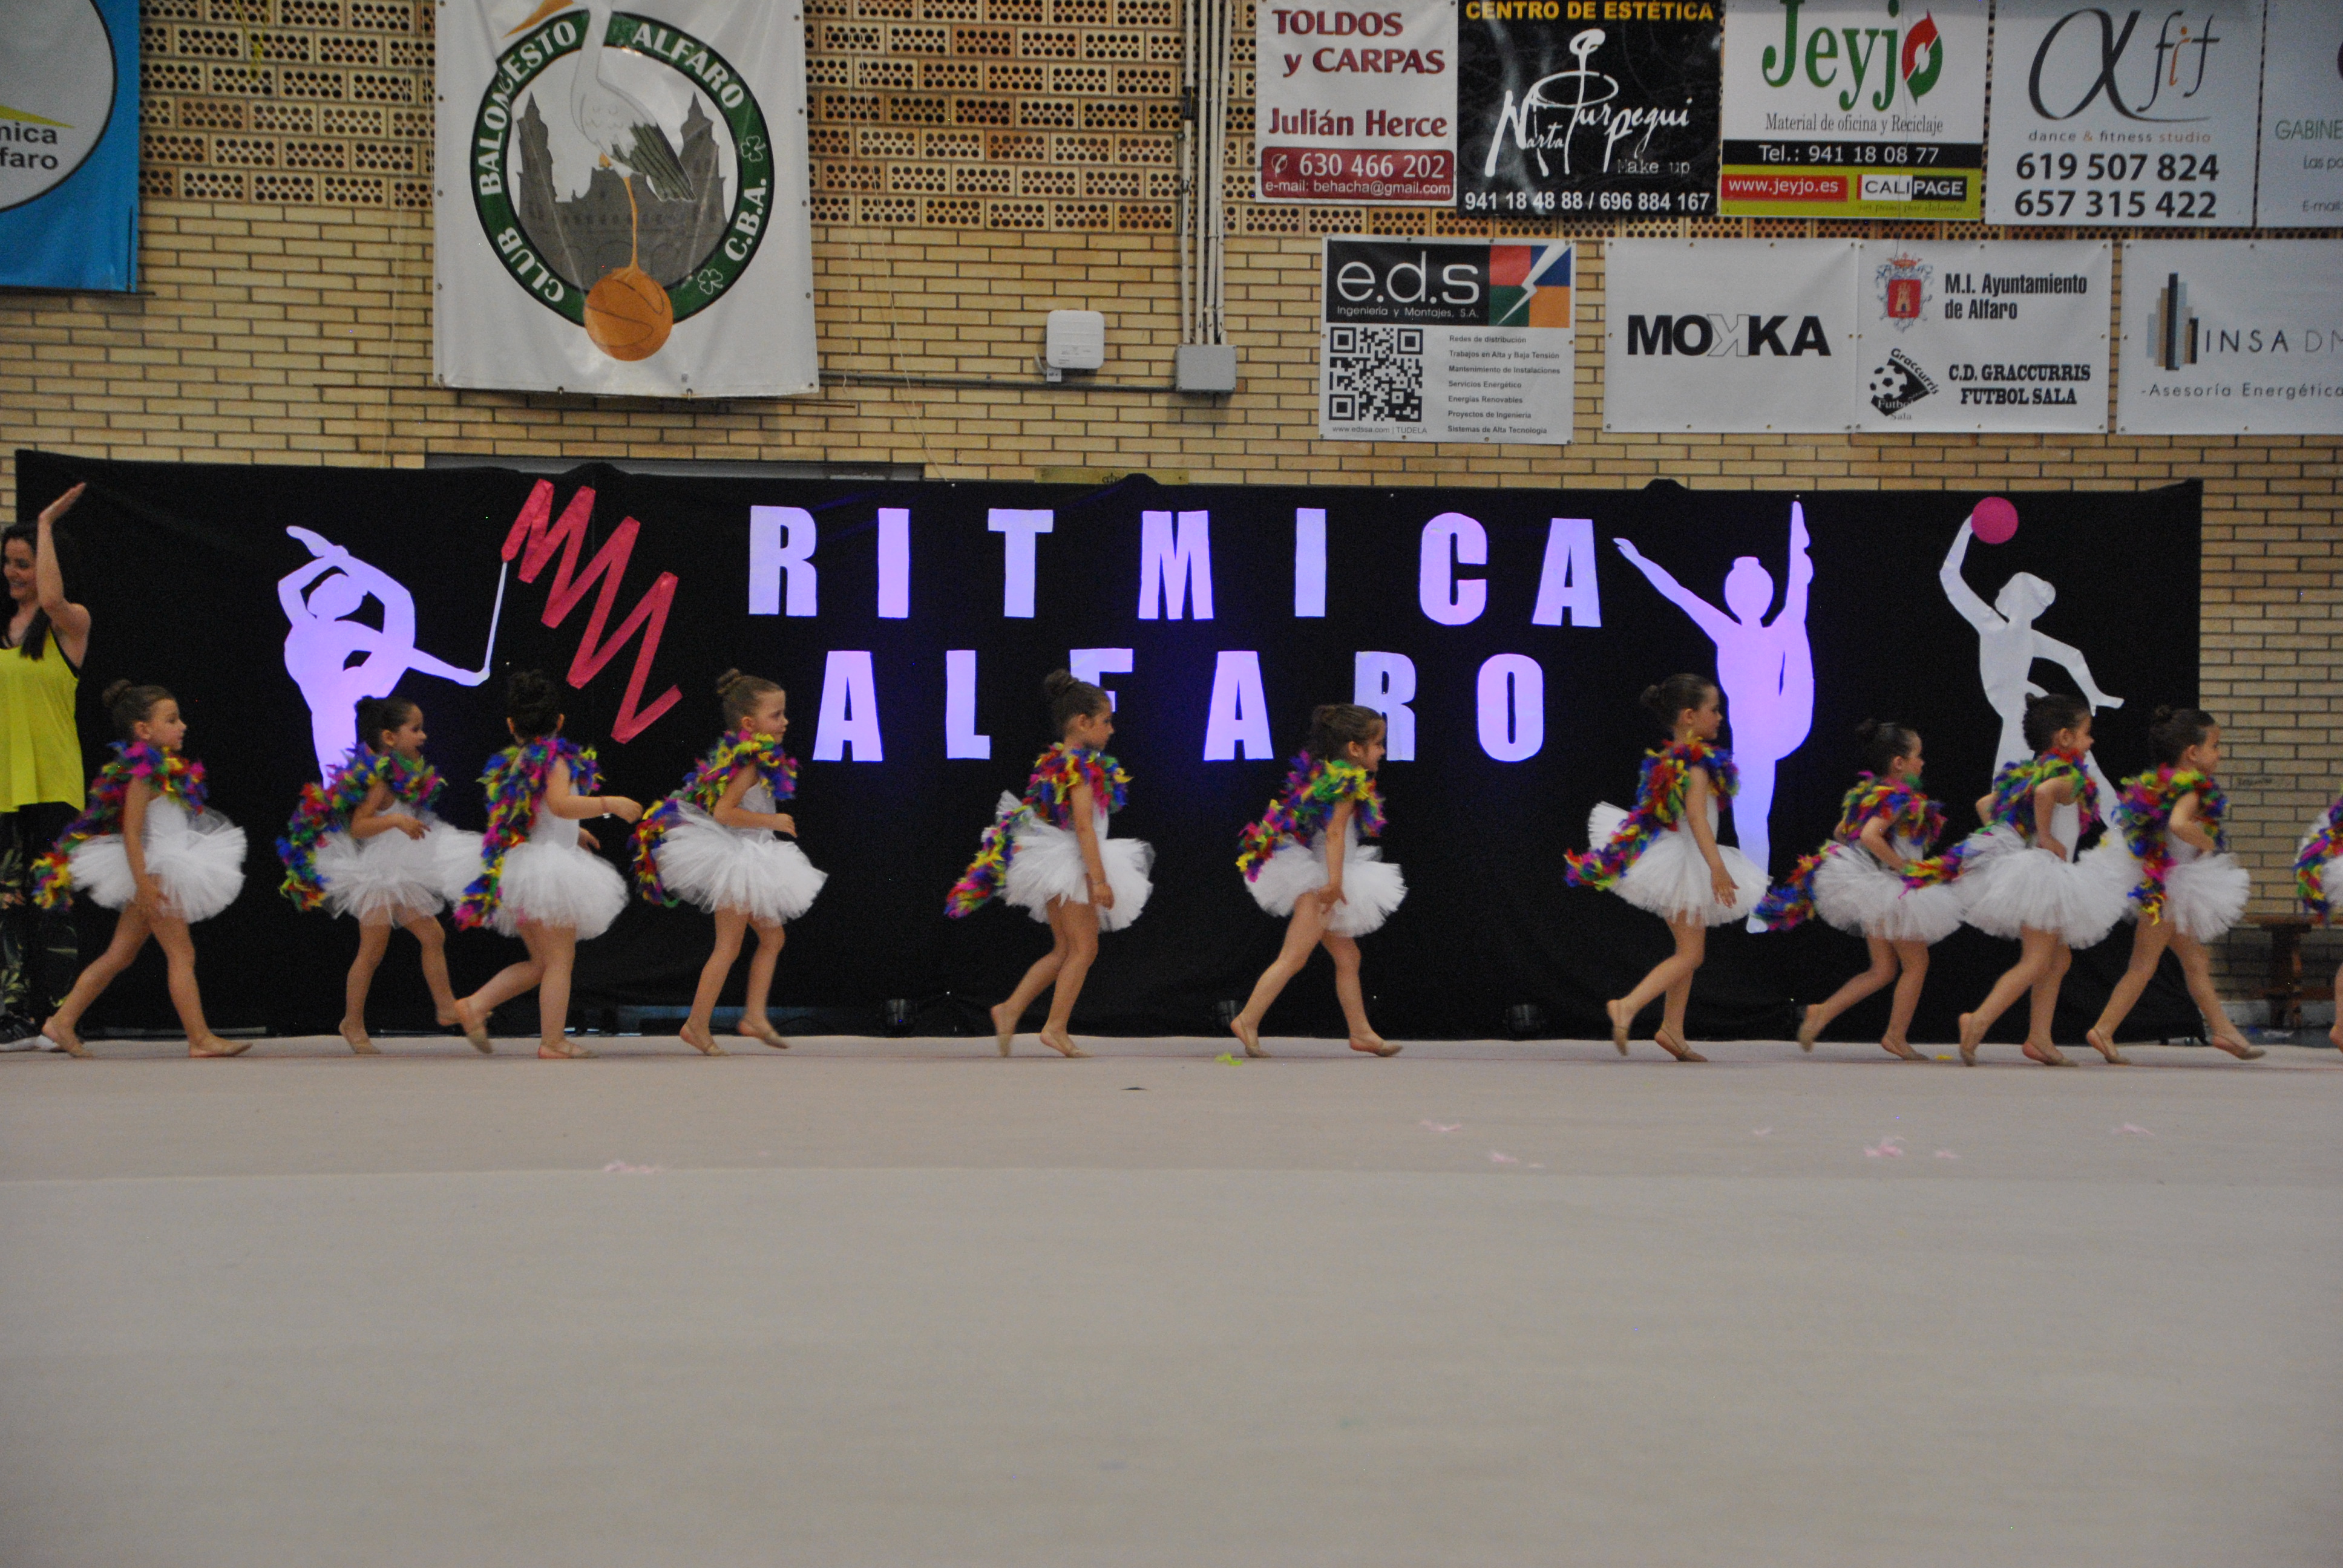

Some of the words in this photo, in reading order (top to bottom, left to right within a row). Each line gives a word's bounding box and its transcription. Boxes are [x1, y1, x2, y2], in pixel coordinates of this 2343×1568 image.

[1466, 1, 1560, 19] CENTRO
[1567, 1, 1596, 19] DE
[1604, 0, 1714, 21] ESTÉTICA
[1271, 9, 1403, 36] TOLDOS
[632, 23, 744, 109] ALFARO
[1282, 54, 1302, 78] y
[1312, 47, 1446, 74] CARPAS
[1268, 108, 1354, 136] Julián
[1366, 109, 1447, 137] Herce
[1766, 113, 1816, 131] Material
[1821, 113, 1834, 130] de
[1838, 113, 1876, 131] oficina
[1881, 120, 1888, 135] y
[1892, 114, 1943, 136] Reciclaje
[2029, 130, 2076, 142] dance
[2083, 131, 2092, 142] &
[2100, 131, 2152, 143] fitness
[2159, 131, 2211, 143] studio
[1299, 152, 1342, 177] 630
[1351, 154, 1394, 177] 466
[1403, 154, 1446, 179] 202
[1758, 144, 1799, 162] Tel.:
[1809, 145, 1843, 163] 941
[1853, 146, 1876, 163] 18
[1884, 146, 1907, 163] 08
[1916, 147, 1939, 164] 77
[1670, 162, 1689, 178] up
[2016, 152, 2077, 180] 619
[2086, 153, 2148, 180] 507
[2157, 153, 2220, 181] 824
[1265, 181, 1309, 192] e-mail:
[1314, 181, 1450, 196] behacha@gmail.com
[1728, 178, 1838, 195] www.jeyjo.es
[1465, 192, 1497, 210] 941
[1506, 192, 1526, 210] 18
[1533, 192, 1555, 210] 48
[1561, 192, 1584, 210] 88
[1600, 192, 1633, 211] 696
[1638, 192, 1671, 211] 884
[1678, 192, 1710, 211] 167
[2014, 190, 2076, 217] 657
[2085, 190, 2146, 217] 315
[2155, 191, 2217, 218] 422
[497, 226, 564, 302] CLUB
[1337, 251, 1480, 304] e.d.s
[1982, 273, 2088, 296] Ayuntamiento
[1945, 299, 1963, 319] de
[1968, 299, 2018, 319] Alfaro
[2206, 330, 2289, 353] INSA
[1891, 348, 1939, 394] Graccurris
[1949, 364, 1978, 381] C.D.
[1982, 364, 2091, 381] GRACCURRIS
[1961, 388, 2028, 405] FUTBOL
[2033, 388, 2077, 405] SALA
[1448, 410, 1483, 419] Proyectos
[749, 505, 1602, 627] RITMICA
